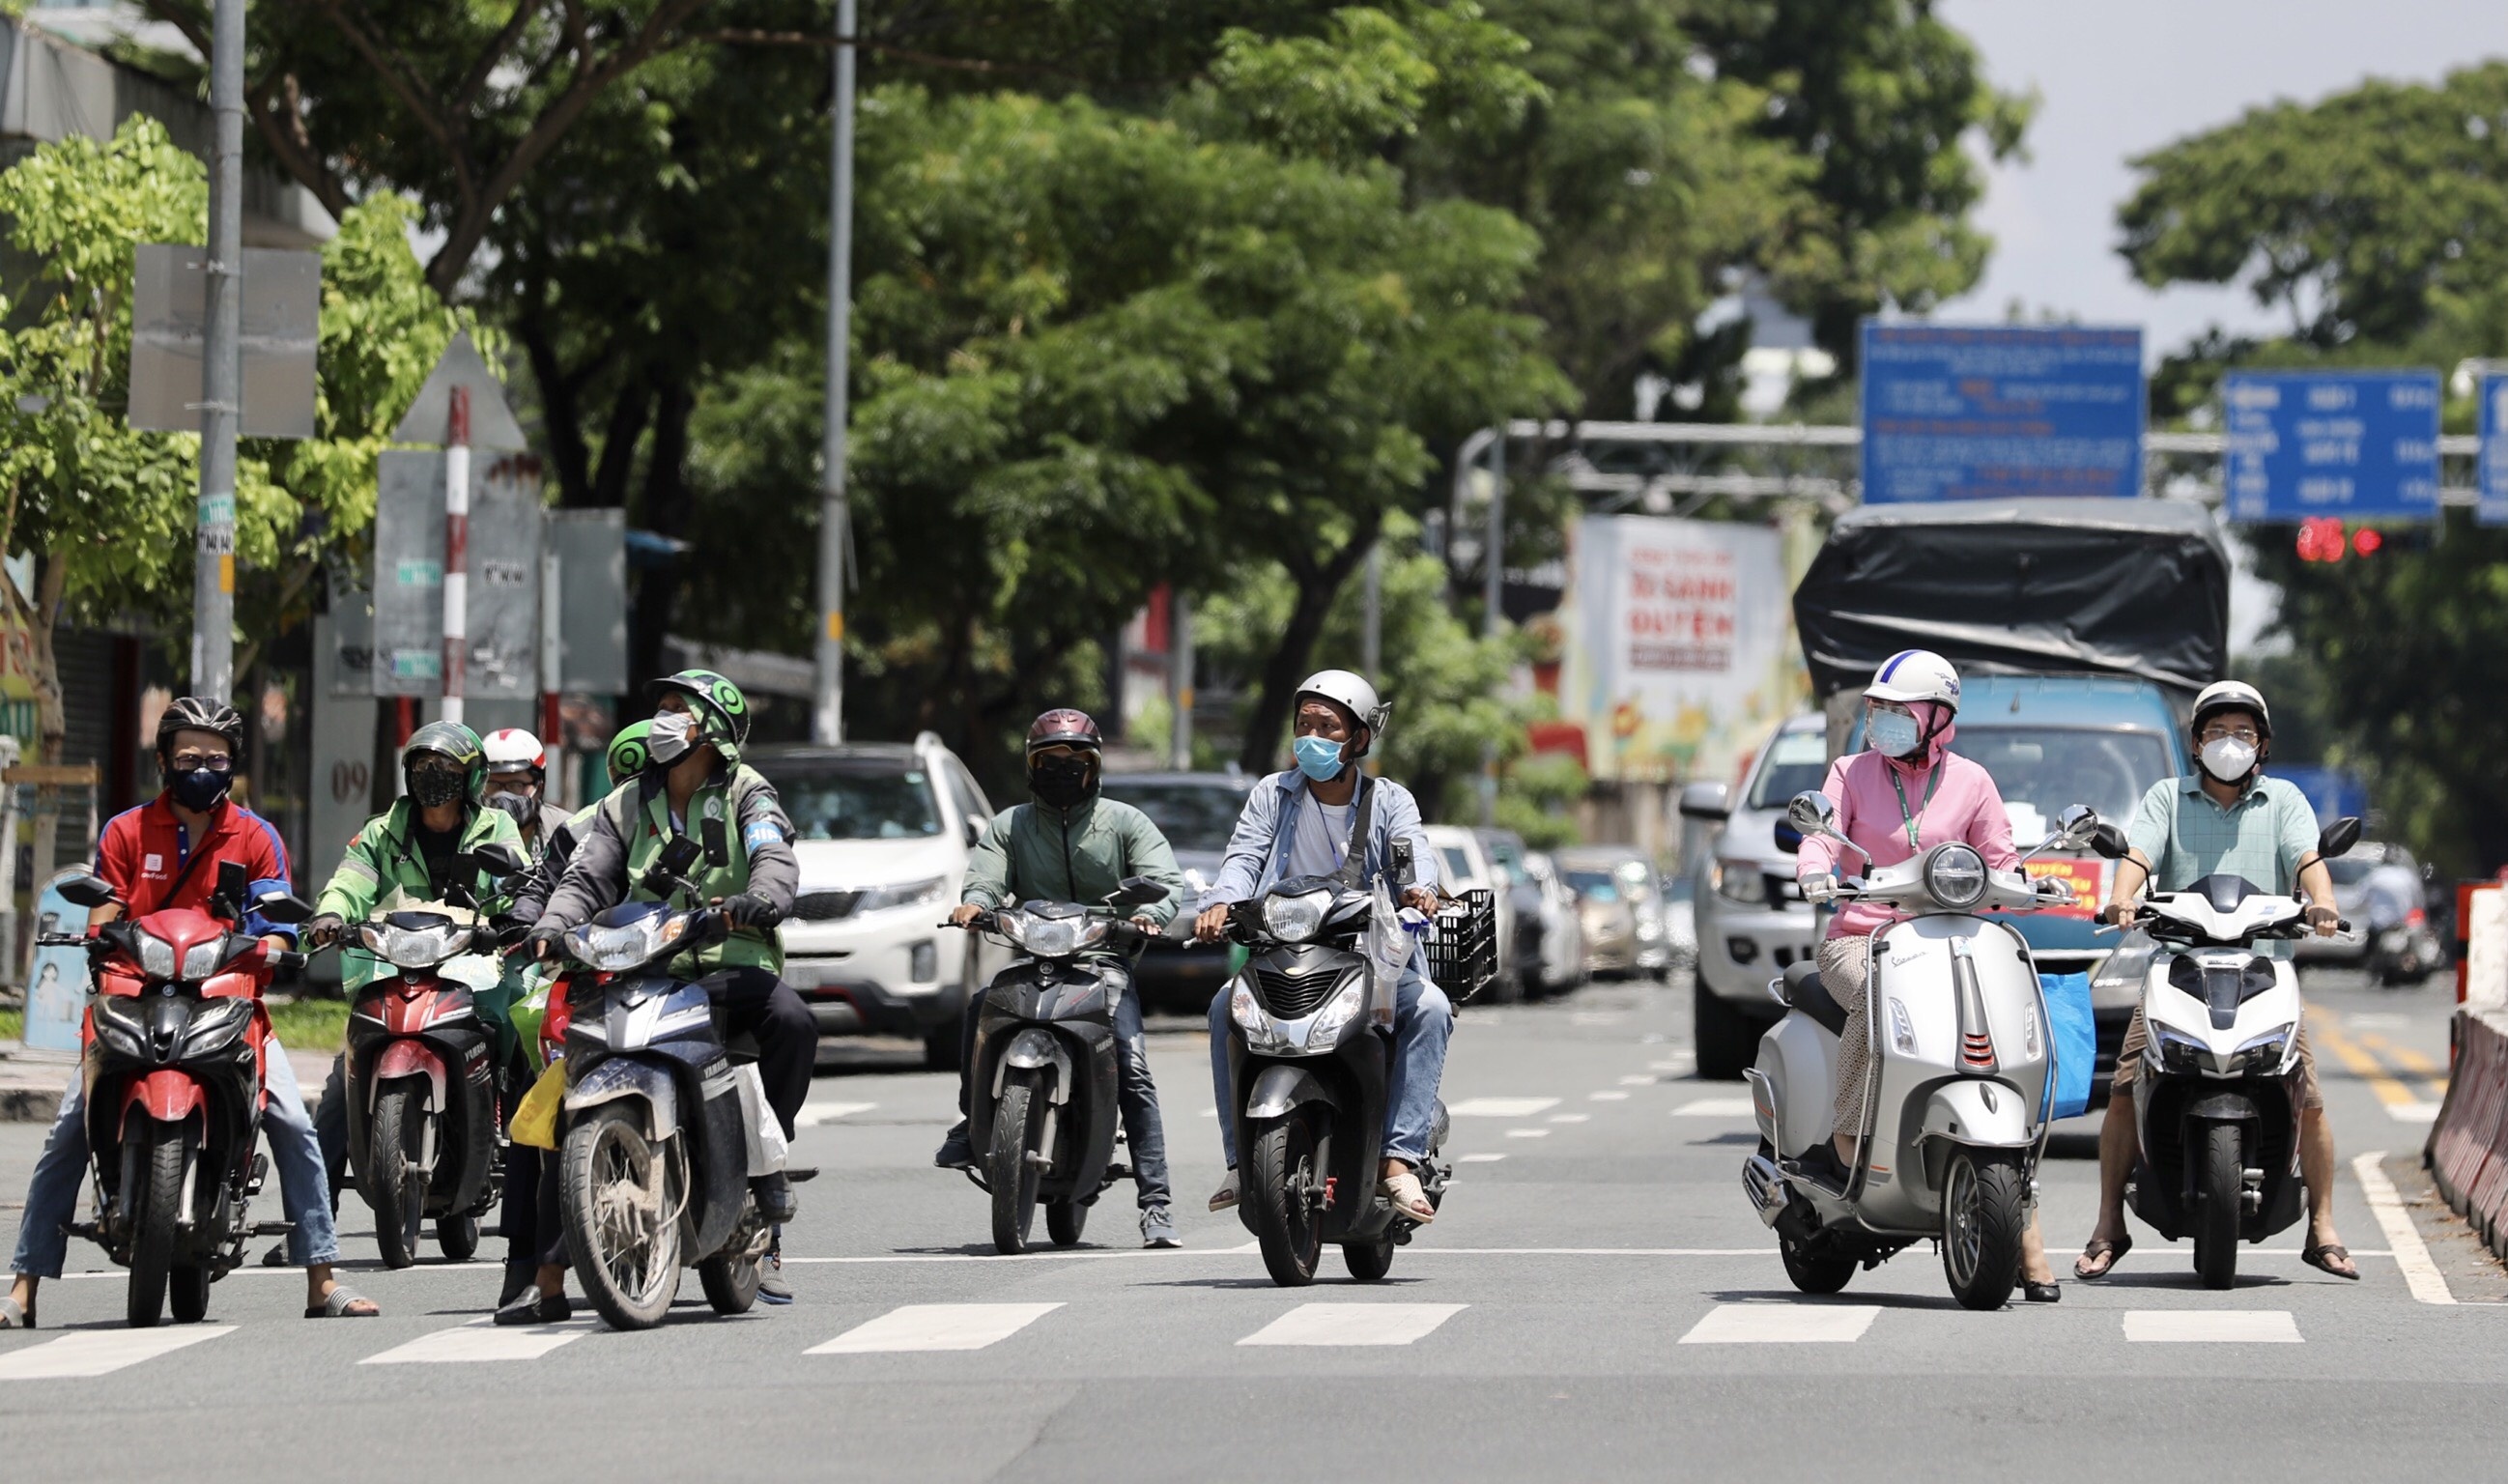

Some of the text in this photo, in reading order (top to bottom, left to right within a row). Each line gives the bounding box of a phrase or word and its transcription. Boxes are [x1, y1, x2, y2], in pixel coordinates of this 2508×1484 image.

[331, 759, 368, 804] 09
[464, 1042, 487, 1063] YAMAHA
[1096, 1036, 1114, 1054] YAMAHA
[703, 1057, 729, 1079] YAMAHA
